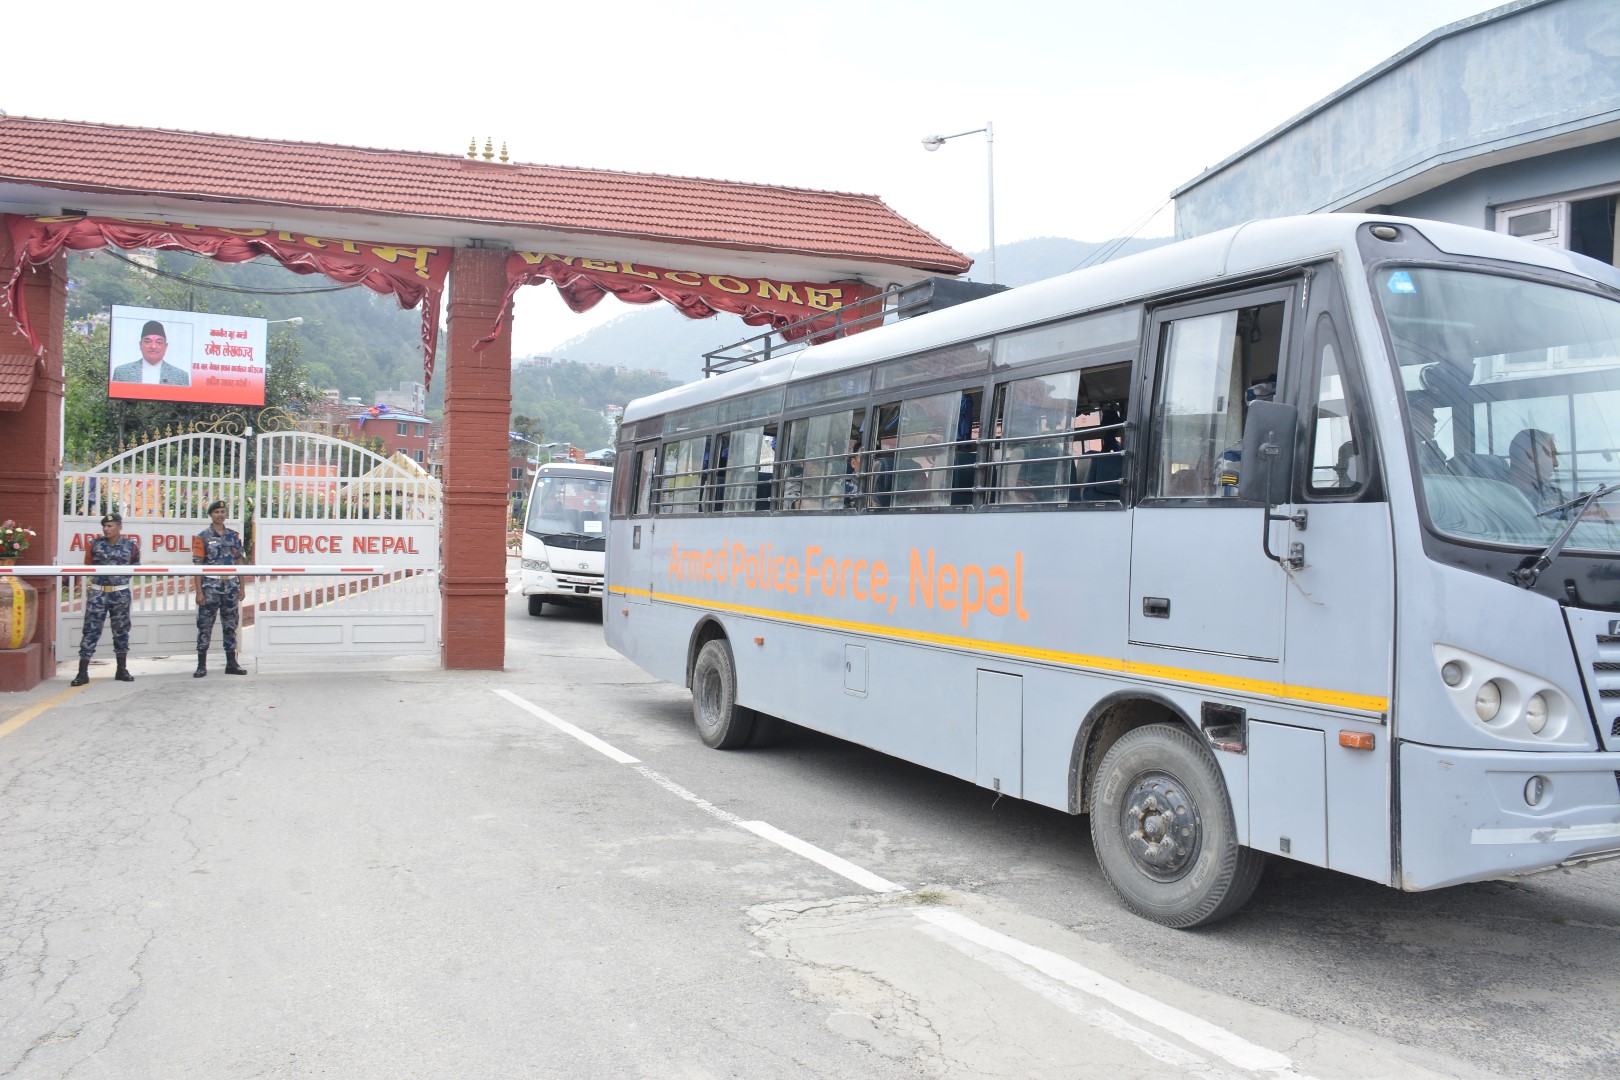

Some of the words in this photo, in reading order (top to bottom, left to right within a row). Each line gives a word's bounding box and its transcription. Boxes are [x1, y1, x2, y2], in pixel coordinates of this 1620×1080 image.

[517, 251, 843, 312] WELCOME
[205, 340, 221, 356] रमेश
[151, 535, 198, 553] POLI
[271, 534, 342, 553] FORCE
[352, 535, 420, 554] NEPAL
[668, 539, 729, 584] Armed
[730, 542, 799, 595] Police
[804, 546, 898, 615] Force,
[909, 547, 1029, 629] Nepal
[1105, 773, 1120, 800] apollo
